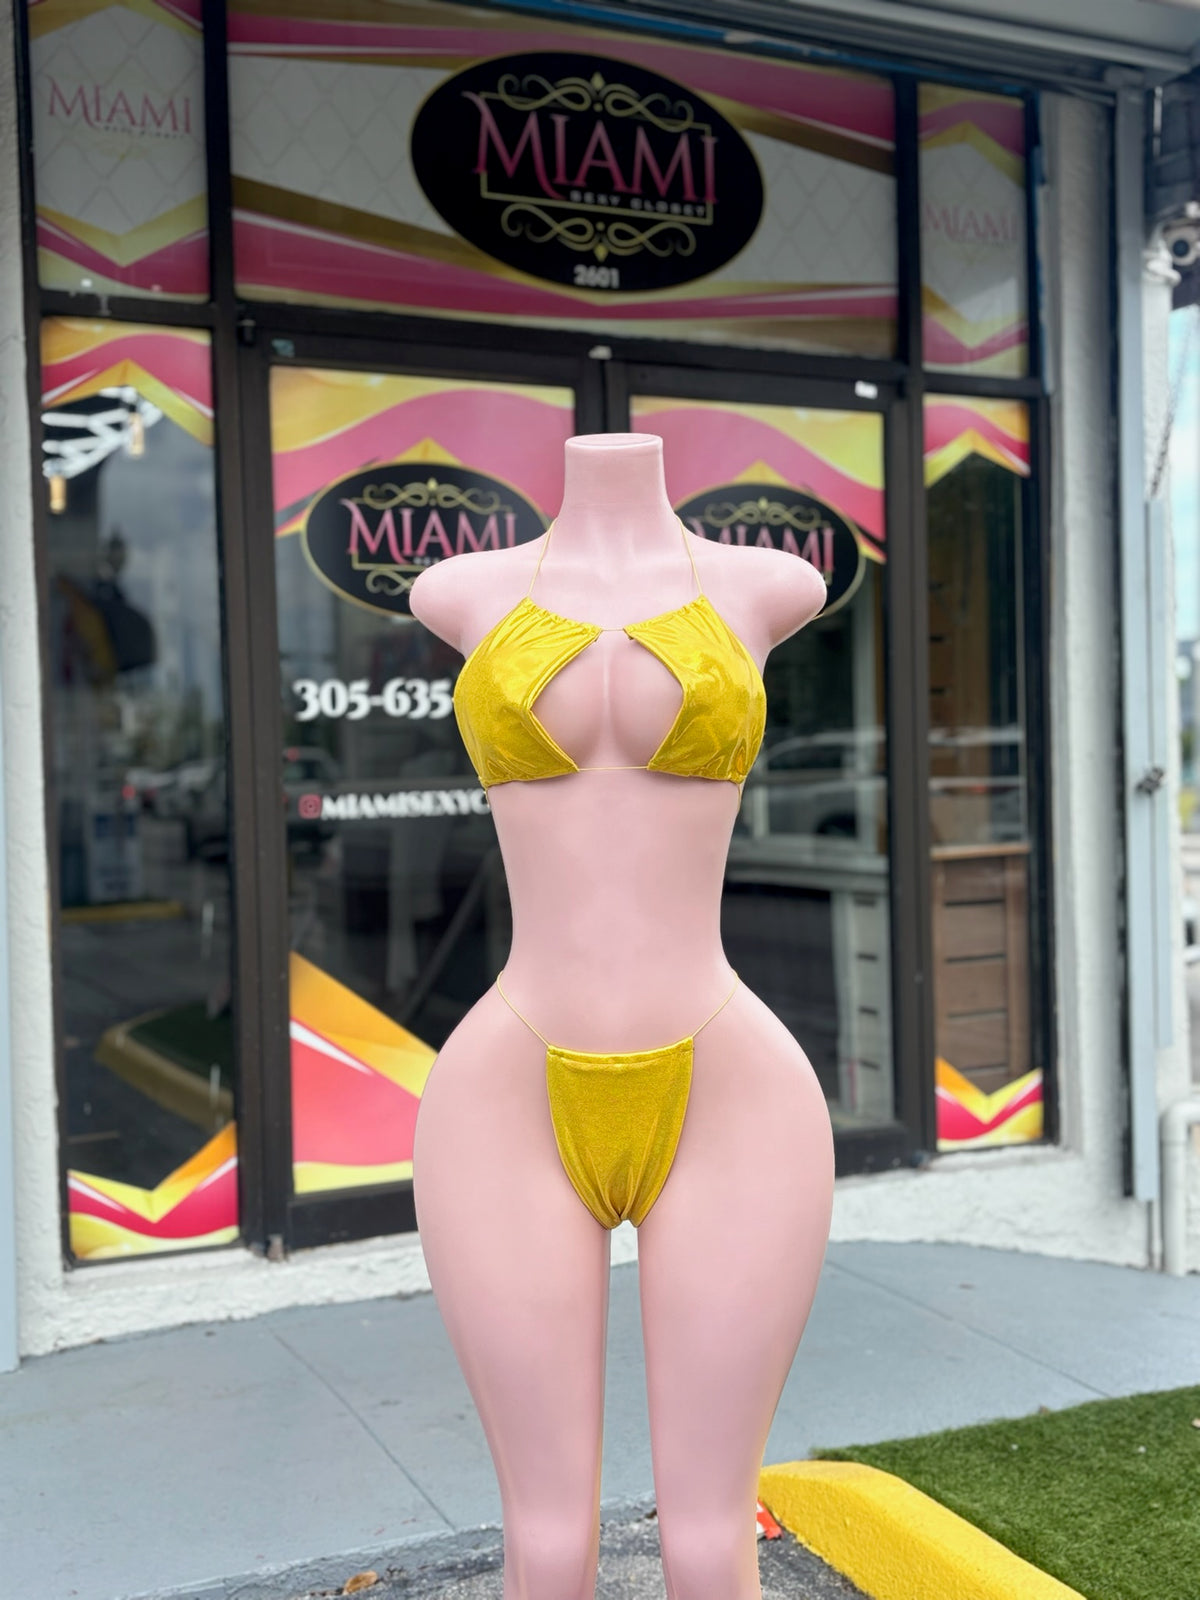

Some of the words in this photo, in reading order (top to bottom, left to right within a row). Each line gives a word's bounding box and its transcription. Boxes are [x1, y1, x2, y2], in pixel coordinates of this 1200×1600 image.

[46, 75, 192, 134] MIAMI
[462, 91, 718, 204] MIAMI
[923, 203, 1018, 240] MIAMI
[573, 264, 620, 289] 2601
[341, 499, 516, 565] MIAMI
